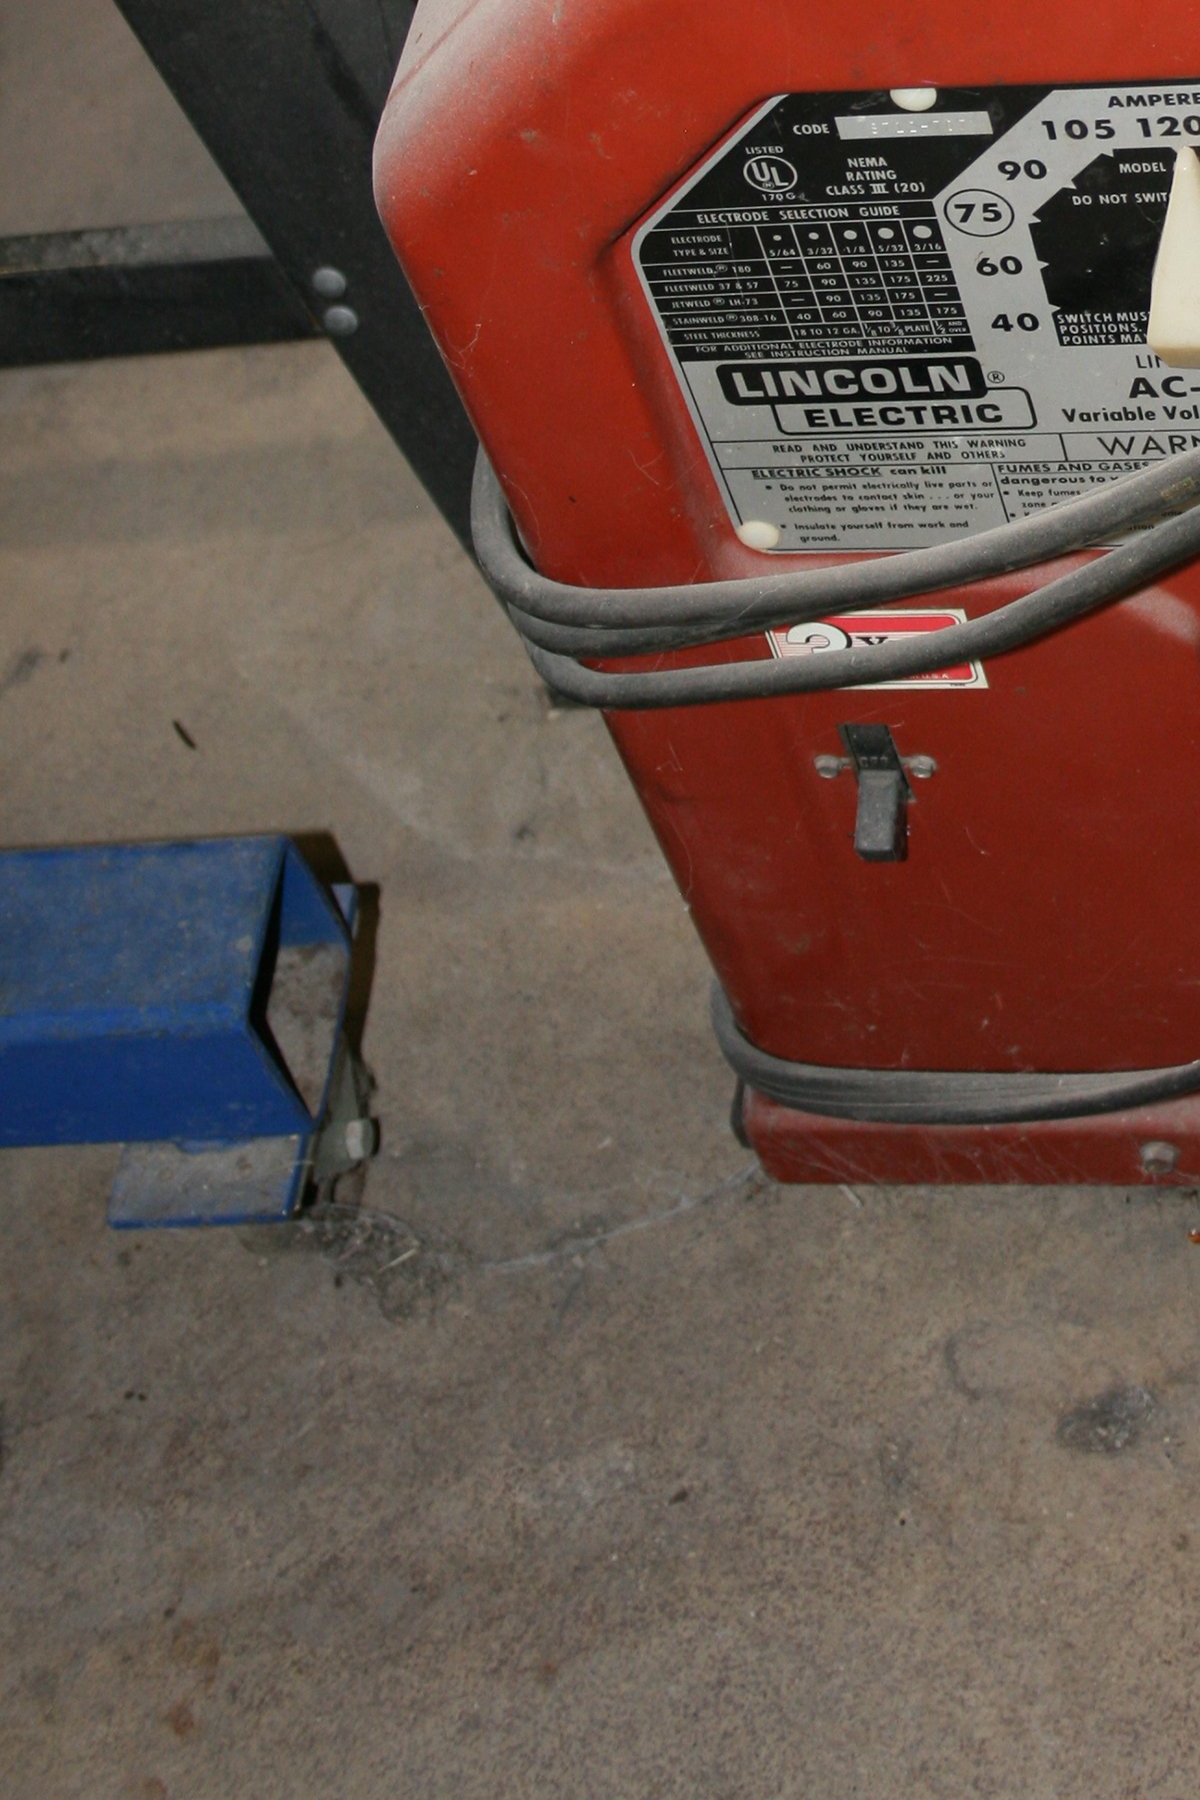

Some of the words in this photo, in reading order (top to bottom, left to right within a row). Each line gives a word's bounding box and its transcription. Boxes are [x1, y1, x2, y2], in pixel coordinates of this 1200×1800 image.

[793, 123, 830, 136] CODE
[1041, 119, 1116, 140] 105
[745, 145, 784, 155] LISTED
[847, 156, 888, 169] NEMA
[998, 159, 1048, 181] 90
[1119, 162, 1166, 174] MODEL
[751, 161, 789, 187] UL
[845, 170, 897, 182] RATING
[826, 184, 865, 196] CLASS
[894, 182, 926, 194] (20)
[1072, 195, 1091, 206] DO
[1100, 194, 1128, 204] NOT
[1135, 192, 1170, 203] SWIT
[696, 210, 770, 225] ELECTRODE
[779, 207, 849, 221] SELECTION
[859, 205, 900, 217] GUIDE
[953, 203, 1002, 224] 75
[671, 234, 722, 244] ELECTRODE
[673, 248, 697, 257] TYPE
[708, 246, 729, 256] SIZE
[769, 248, 796, 257] 5/64
[806, 246, 834, 256] 3/32
[878, 244, 904, 253] 5/32
[914, 242, 941, 252] 3/16
[732, 264, 751, 274] 180
[817, 261, 831, 270] 60
[852, 260, 867, 269] 90
[885, 258, 905, 267] 135
[976, 255, 1023, 276] 60
[664, 283, 714, 293] FLEETWELD
[719, 282, 731, 291] 37
[746, 281, 759, 290] 57
[784, 280, 799, 289] 75
[821, 278, 837, 287] 90
[855, 276, 876, 286] 135
[890, 275, 911, 284] 175
[926, 273, 948, 283] 225
[672, 300, 710, 309] JETWELD
[826, 294, 841, 303] 90
[895, 291, 915, 300] 175
[672, 315, 725, 326] STAINWELD
[739, 313, 777, 323] 308-16
[797, 312, 811, 321] 40
[832, 311, 847, 319] 60
[868, 309, 883, 318] 90
[901, 308, 921, 317] 135
[936, 307, 957, 316] 175
[991, 312, 1040, 332] 40
[1057, 312, 1113, 324] SWITCH
[1116, 311, 1151, 322] MUS
[684, 331, 709, 341] STEEL
[711, 329, 760, 340] THICKNESS
[904, 323, 930, 334] PLATE
[1060, 322, 1142, 334] POSITIONS.
[695, 344, 718, 353] FOR
[724, 342, 791, 352] ADDITIONAL
[799, 339, 864, 349] ELECTRODE
[868, 336, 953, 347] INFORMATION
[1062, 334, 1116, 345] POINTS
[770, 348, 847, 358] INSTRUCTION
[857, 346, 908, 356] MANUAL
[731, 365, 971, 398] LINCOLN
[803, 404, 1003, 428] ELECTRIC
[1062, 407, 1156, 423] Variable
[772, 444, 802, 454] READ
[812, 443, 837, 452] AND
[846, 441, 925, 452] UNDERSTAND
[933, 441, 959, 449] THIS
[967, 438, 1026, 449] WARNING
[801, 454, 850, 463] PROTECT
[859, 452, 916, 462] YOURSELF
[927, 451, 951, 460] AND
[961, 450, 1005, 460] OTHERS
[752, 468, 822, 479] ELECTRIC
[826, 466, 881, 477] SHOCK
[890, 467, 917, 476] can
[921, 466, 947, 475] kill
[998, 463, 1051, 473] FUMES
[1057, 462, 1092, 472] AND
[1000, 475, 1085, 488] dangerous
[1089, 475, 1106, 484] to
